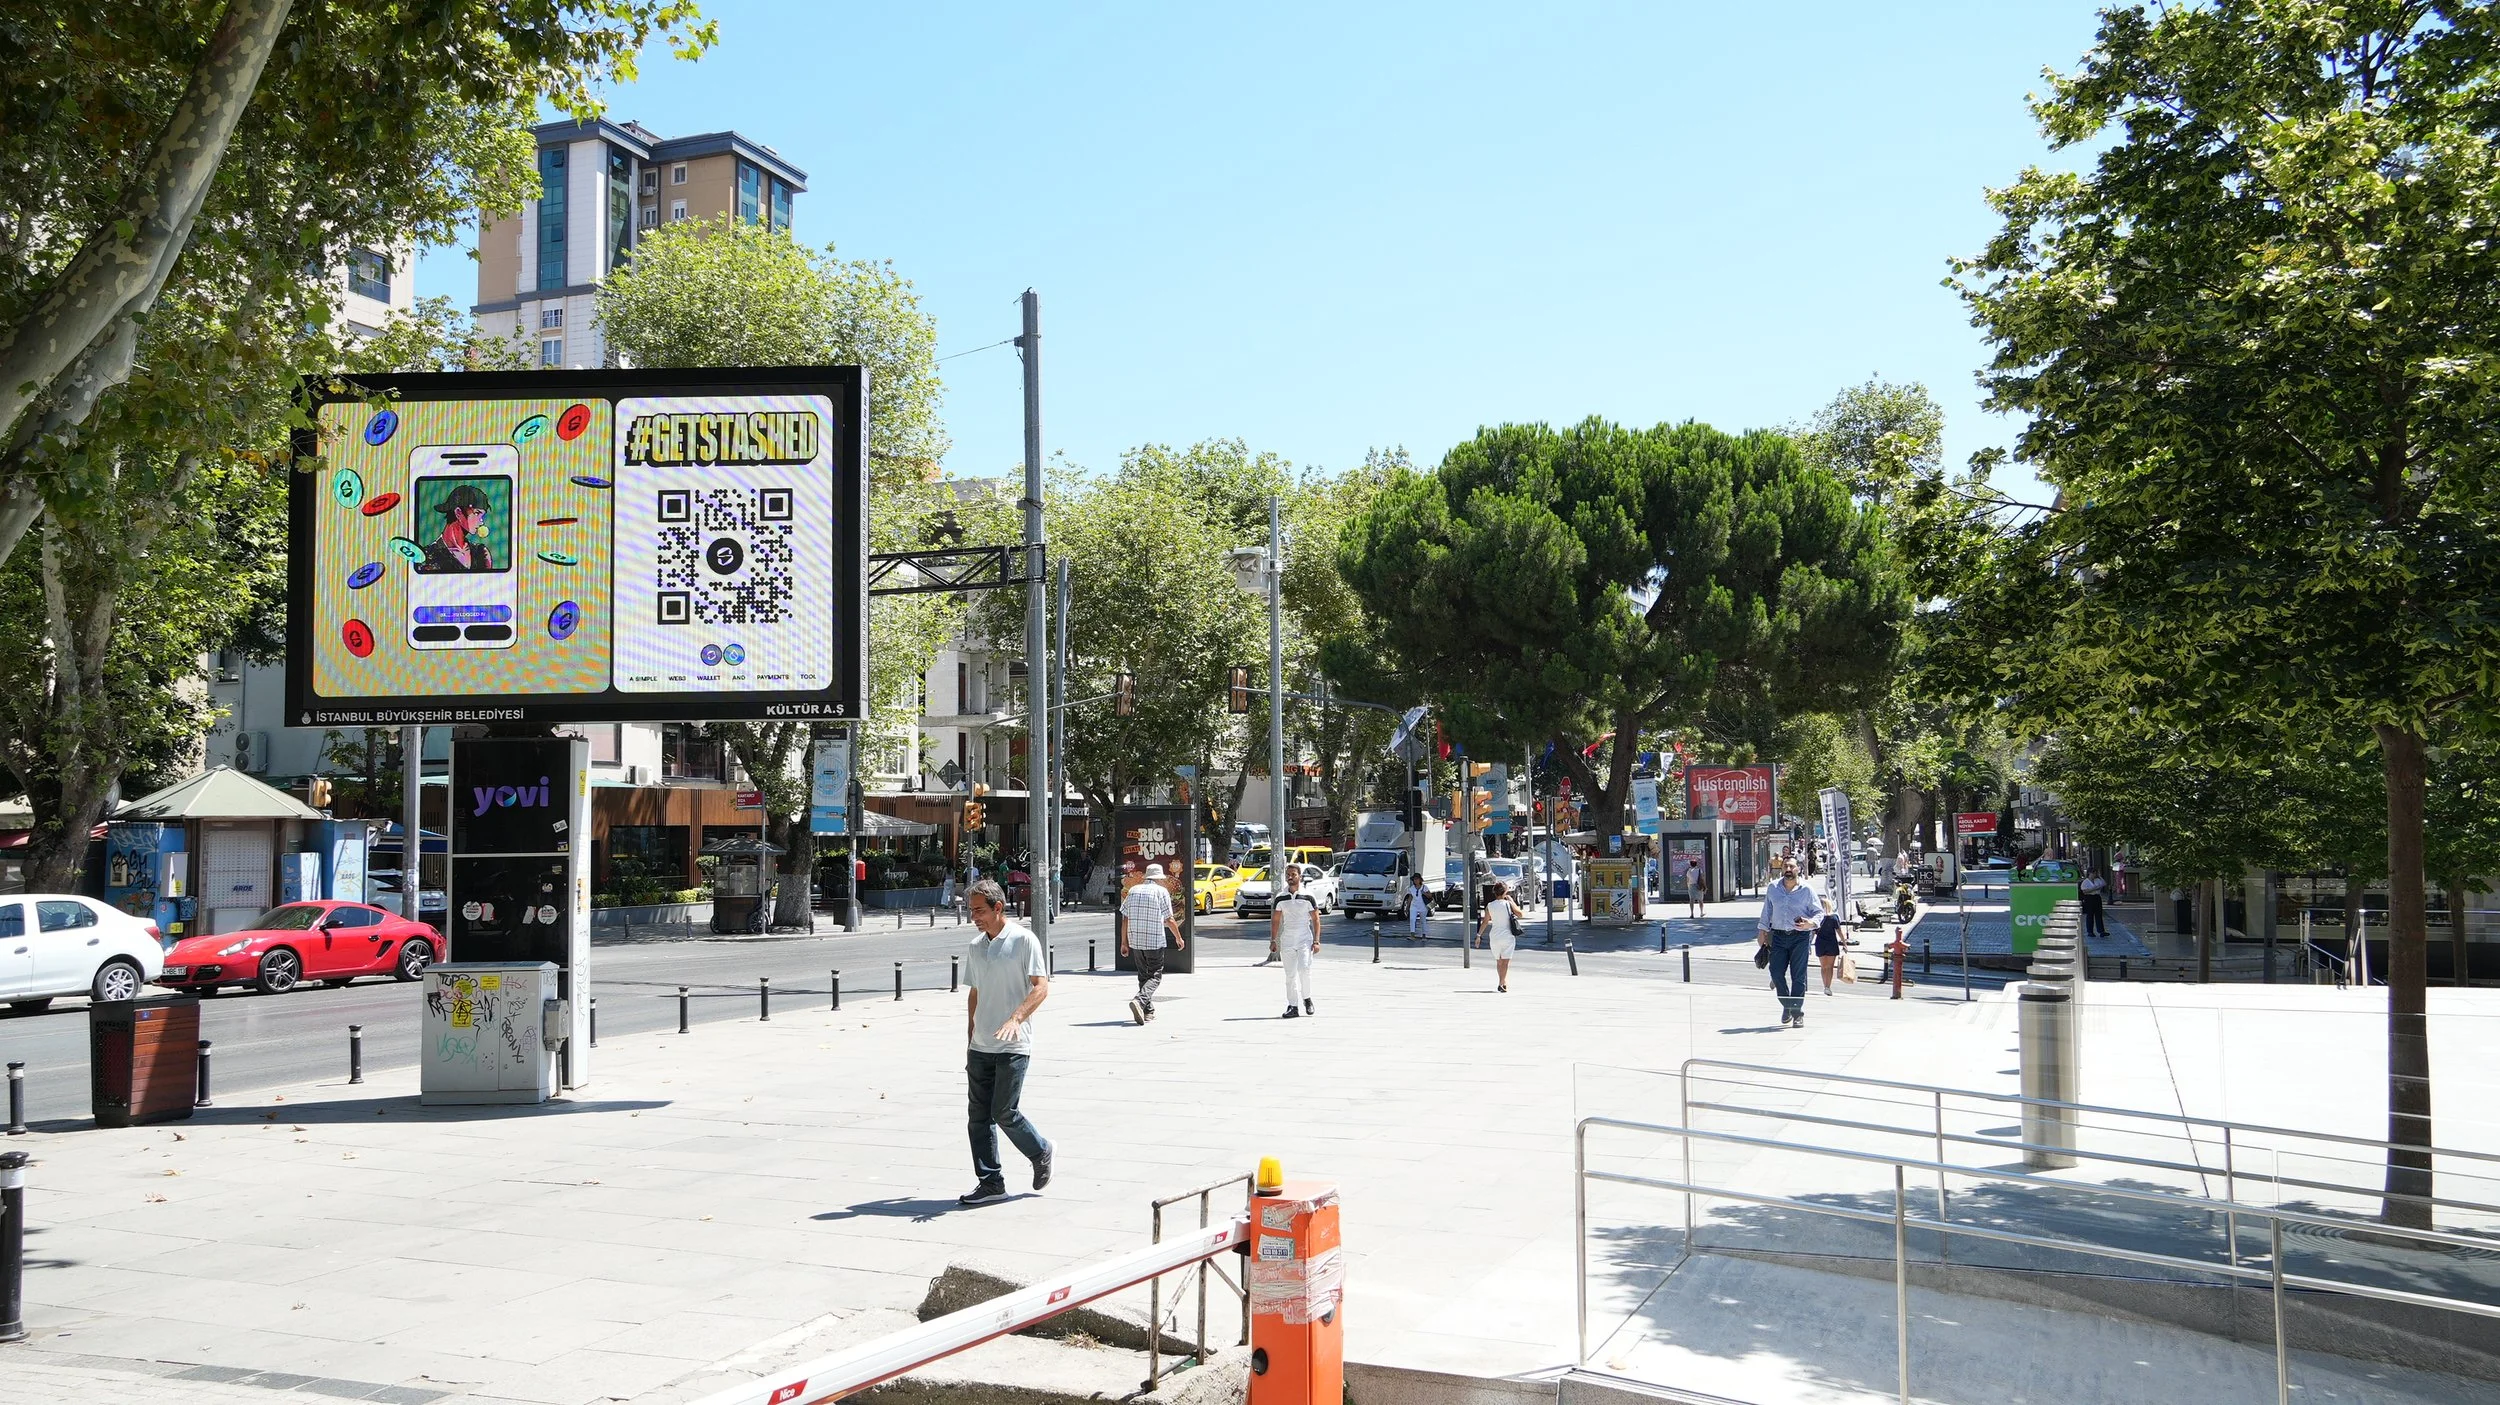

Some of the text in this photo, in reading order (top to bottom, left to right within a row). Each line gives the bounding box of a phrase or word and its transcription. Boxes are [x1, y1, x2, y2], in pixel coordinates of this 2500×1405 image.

[627, 412, 818, 464] #GETSTASHED
[316, 707, 524, 723] İSTANBUL BÜYÜKŞEHİR BELEDİYESİ
[766, 704, 844, 716] KÜLTÜR A.Ş
[1693, 775, 1767, 793] Justenglish
[473, 775, 550, 818] yovi
[1138, 827, 1163, 841] BIG
[1138, 841, 1176, 860] KING
[1919, 871, 1933, 880] HC
[779, 1388, 796, 1401] Nice
